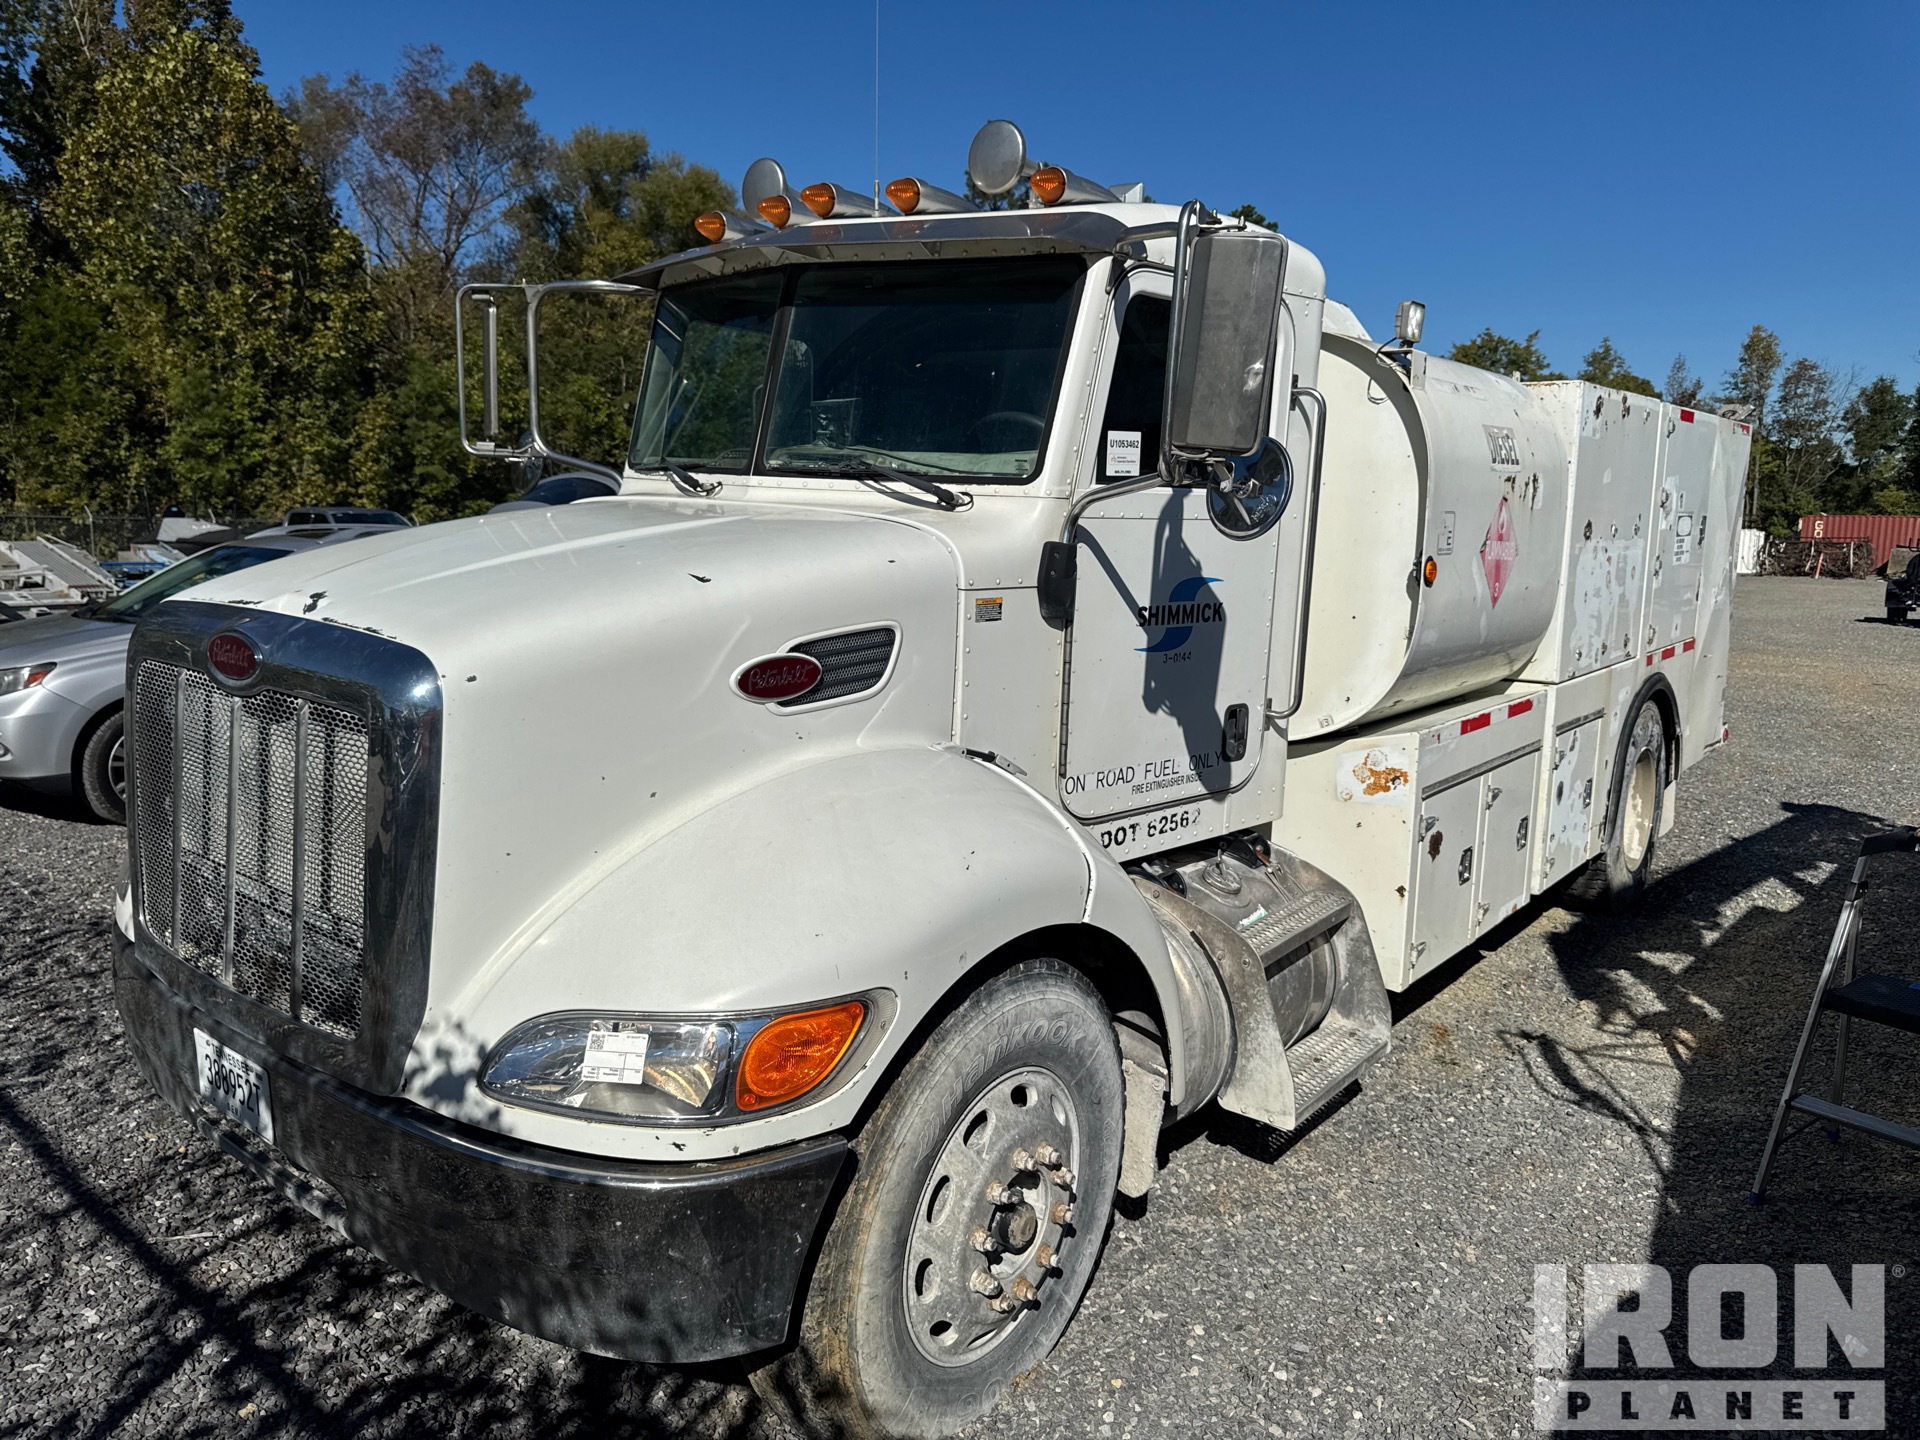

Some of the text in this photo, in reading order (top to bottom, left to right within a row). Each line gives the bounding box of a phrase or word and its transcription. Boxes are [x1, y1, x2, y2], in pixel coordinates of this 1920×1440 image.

[1487, 431, 1520, 466] DIESEL
[1137, 602, 1223, 627] SHIMMICK
[748, 664, 814, 692] Peterbilt
[1065, 750, 1224, 795] ON ROAD FUEL ONLY
[1131, 772, 1202, 796] FIRE EXTINGUISHER INSIDE
[1100, 821, 1141, 849] DOT
[211, 1043, 251, 1077] TENNESSEE
[205, 1053, 261, 1117] 388952T
